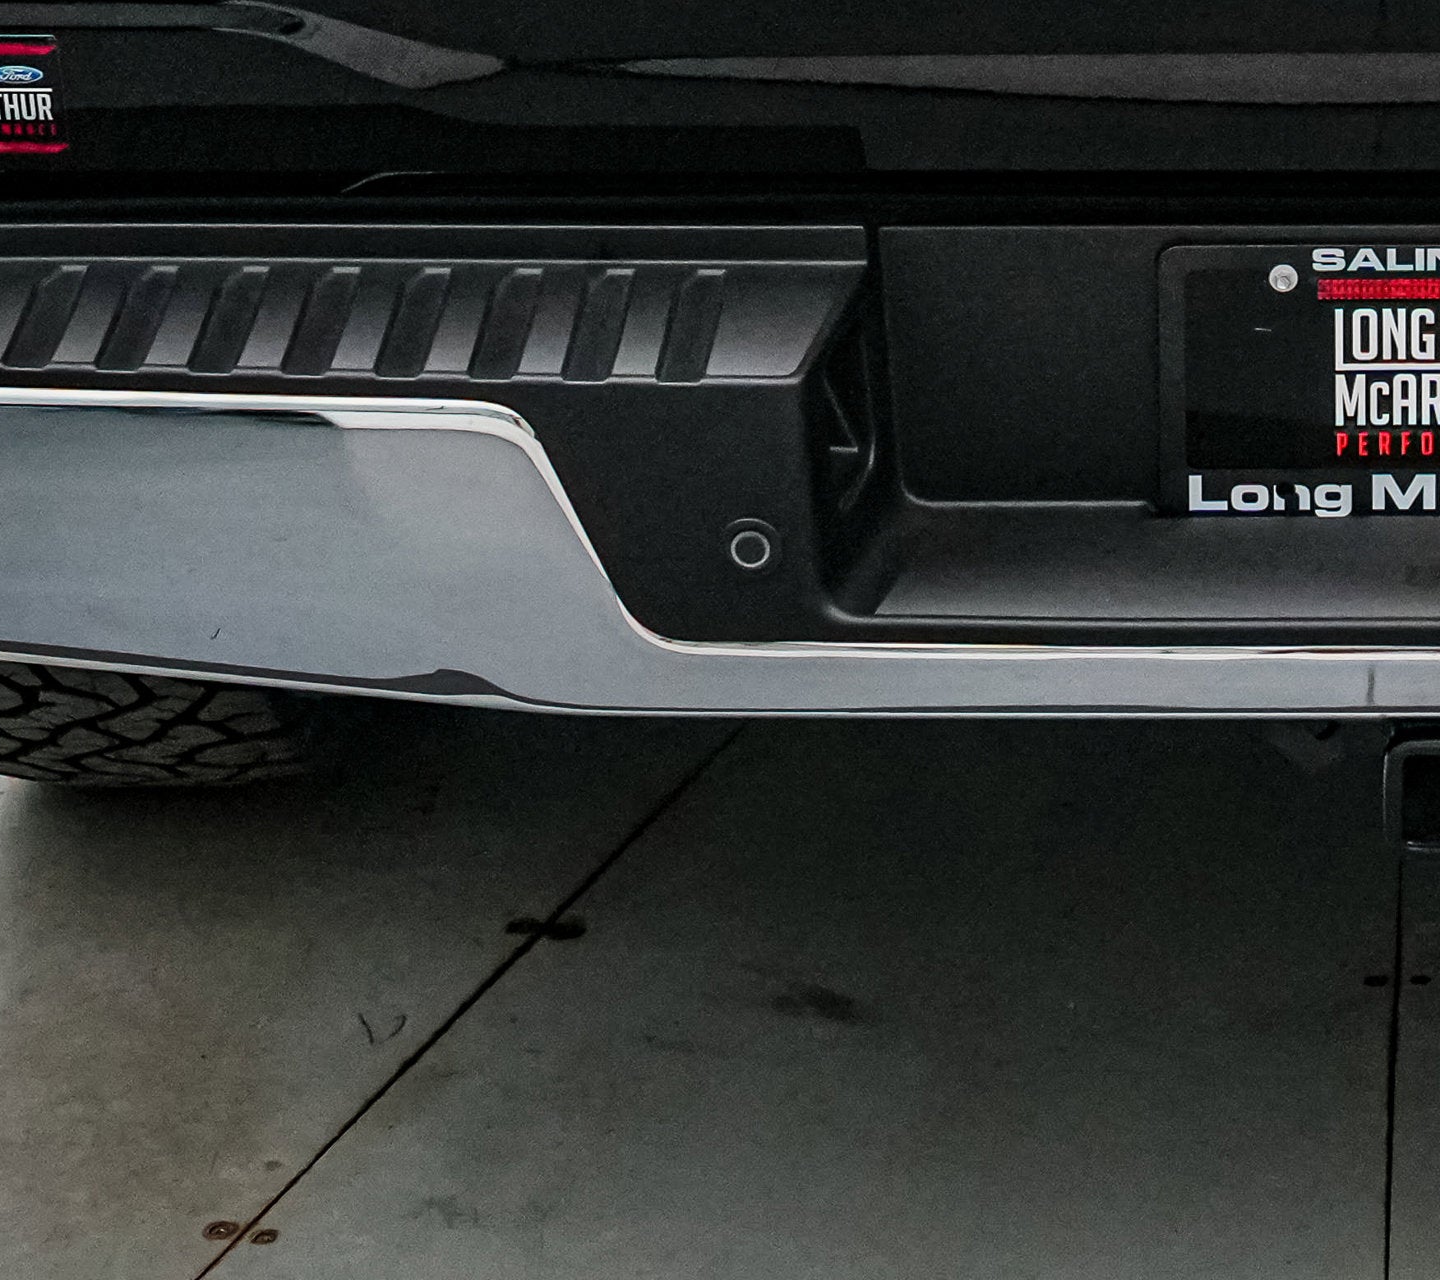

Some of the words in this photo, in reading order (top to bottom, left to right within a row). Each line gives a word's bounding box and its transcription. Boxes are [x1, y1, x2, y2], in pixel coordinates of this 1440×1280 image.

[0, 69, 34, 81] Ford
[1334, 308, 1436, 371] LONG
[1188, 474, 1353, 518] Long
